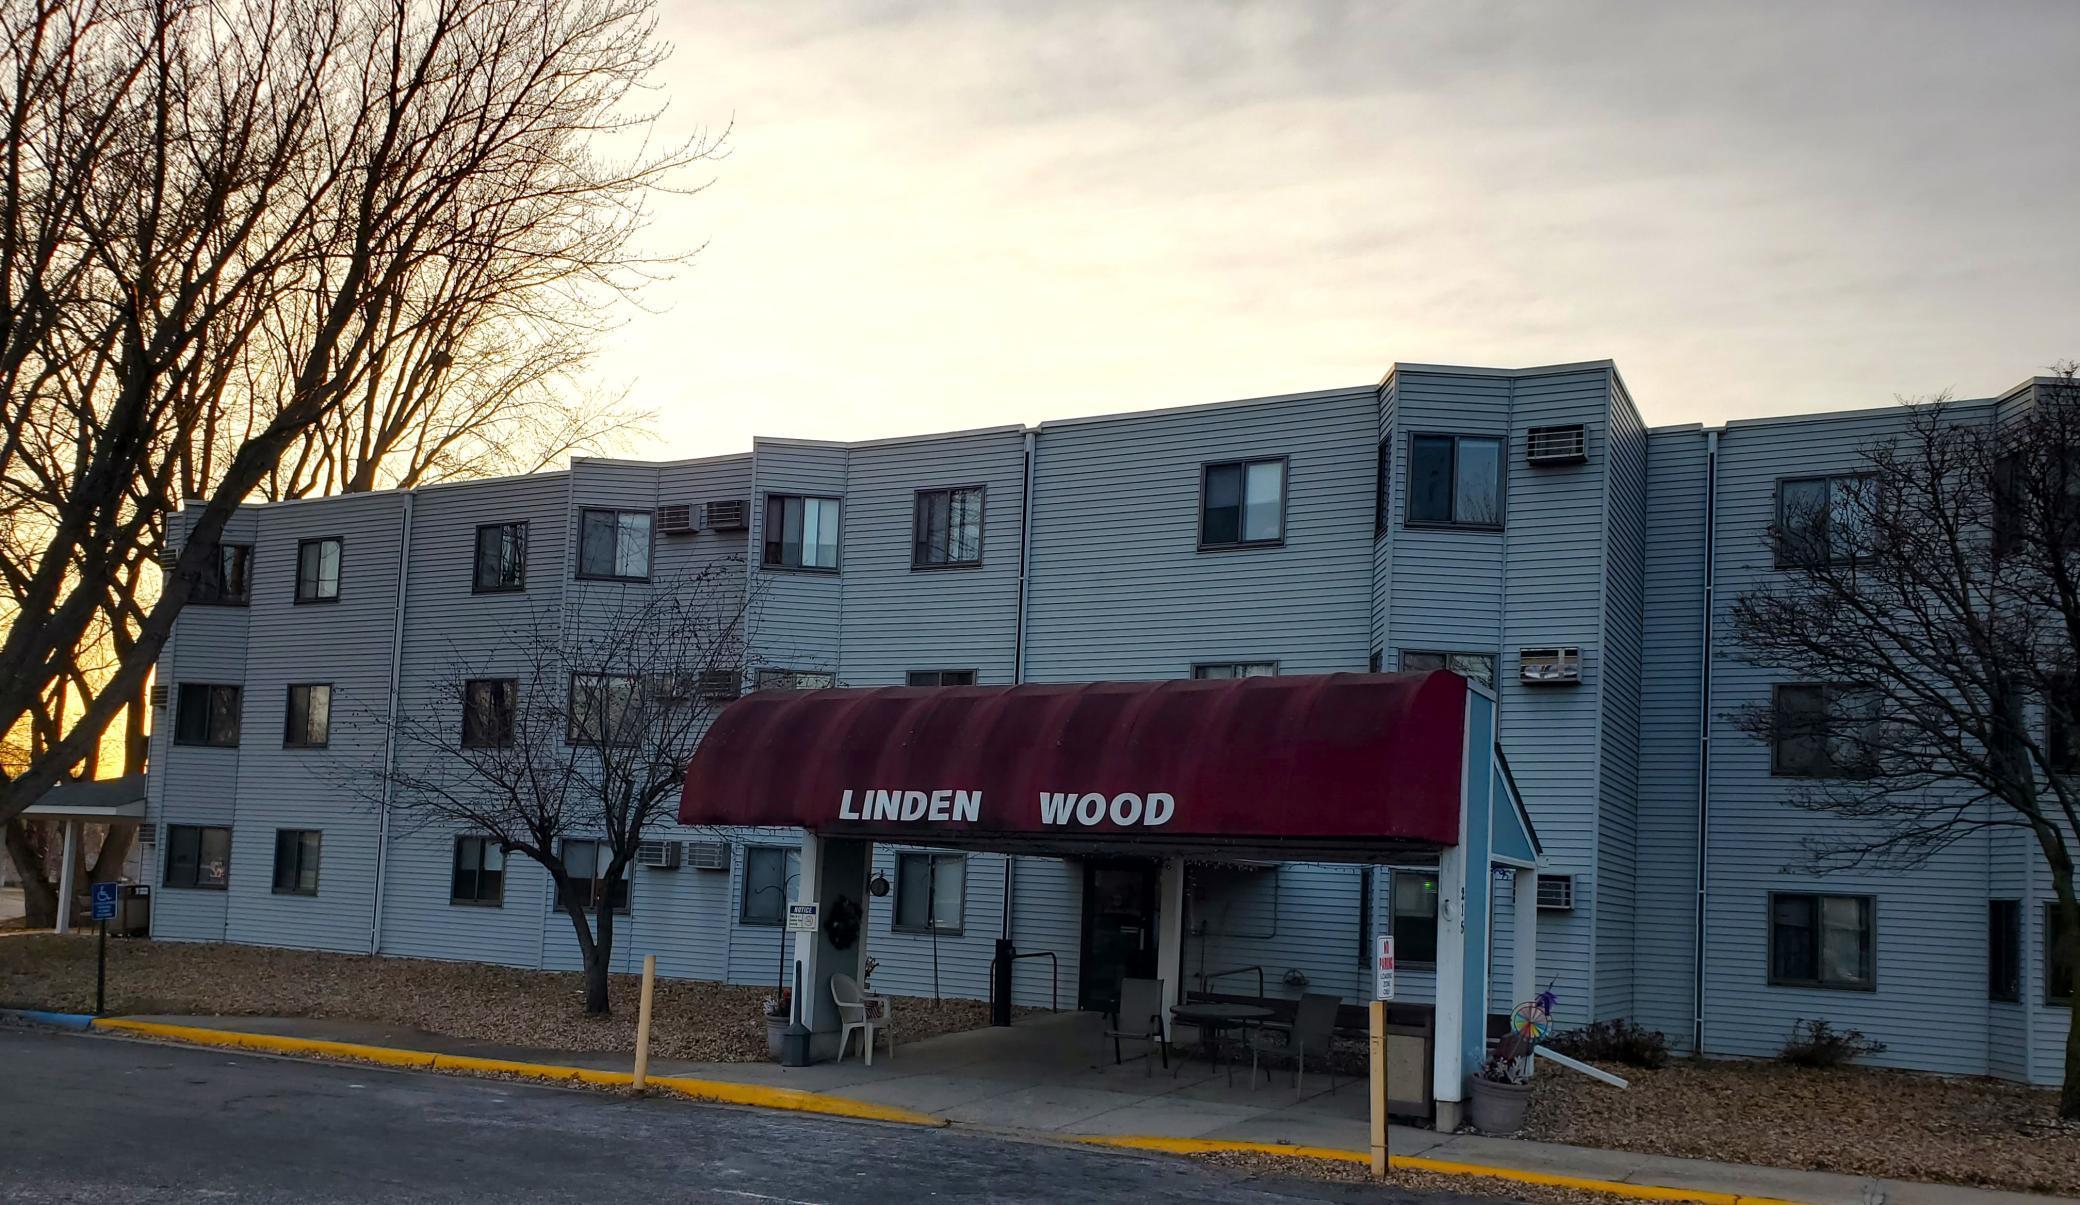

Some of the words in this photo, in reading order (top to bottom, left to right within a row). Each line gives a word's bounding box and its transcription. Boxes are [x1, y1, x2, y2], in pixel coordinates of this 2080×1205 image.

[839, 789, 983, 822] LINDEN
[1039, 792, 1176, 826] WOOD
[793, 906, 813, 914] NOTICE
[1383, 940, 1390, 954] NO
[1379, 956, 1393, 970] PARKING
